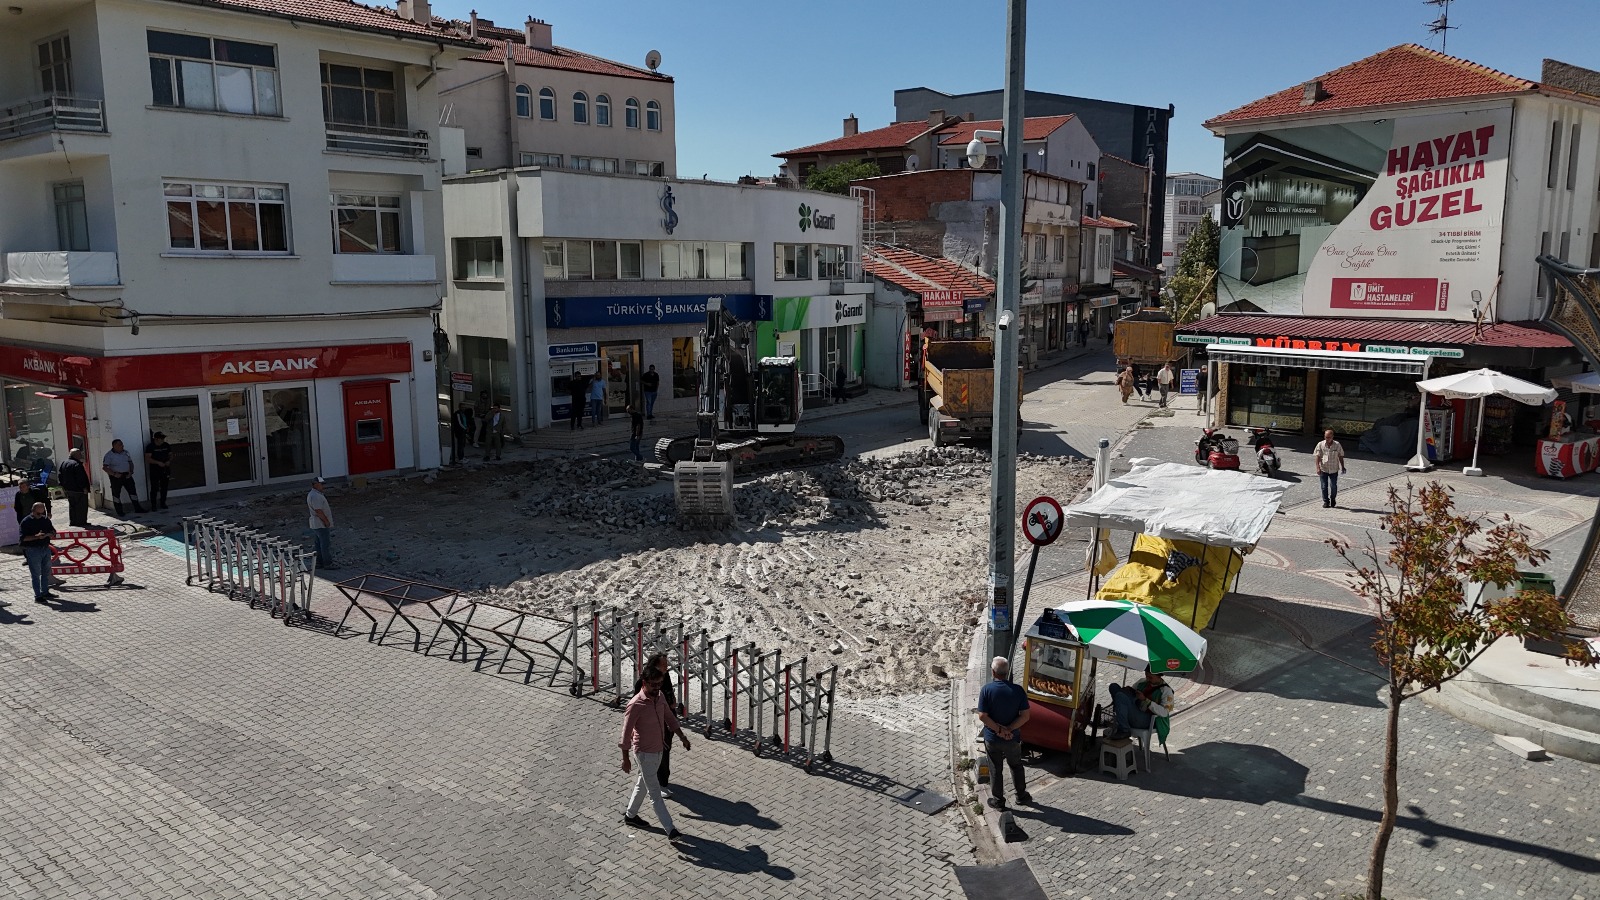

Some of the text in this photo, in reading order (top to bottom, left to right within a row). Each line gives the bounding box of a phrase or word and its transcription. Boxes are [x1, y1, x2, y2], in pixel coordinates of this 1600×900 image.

[1387, 125, 1495, 176] HAYAT
[1396, 160, 1485, 197] ŞAĞLIKLA
[1369, 188, 1482, 231] GÜZEL
[813, 208, 835, 230] Garanti
[1463, 229, 1481, 237] BİRİM
[924, 291, 962, 301] HAKAN ET
[1367, 283, 1385, 293] ÜMİT
[1366, 292, 1414, 302] HASTANELERİ
[606, 303, 653, 316] TÜRKİYE
[665, 303, 706, 314] BANKAS
[842, 302, 863, 318] Garanti
[556, 345, 590, 354] Bankamatik
[1177, 335, 1216, 343] Kuruyemiş
[1367, 346, 1406, 354] Bakliyat
[23, 357, 57, 374] AKBANK
[220, 357, 318, 375] AKBANK
